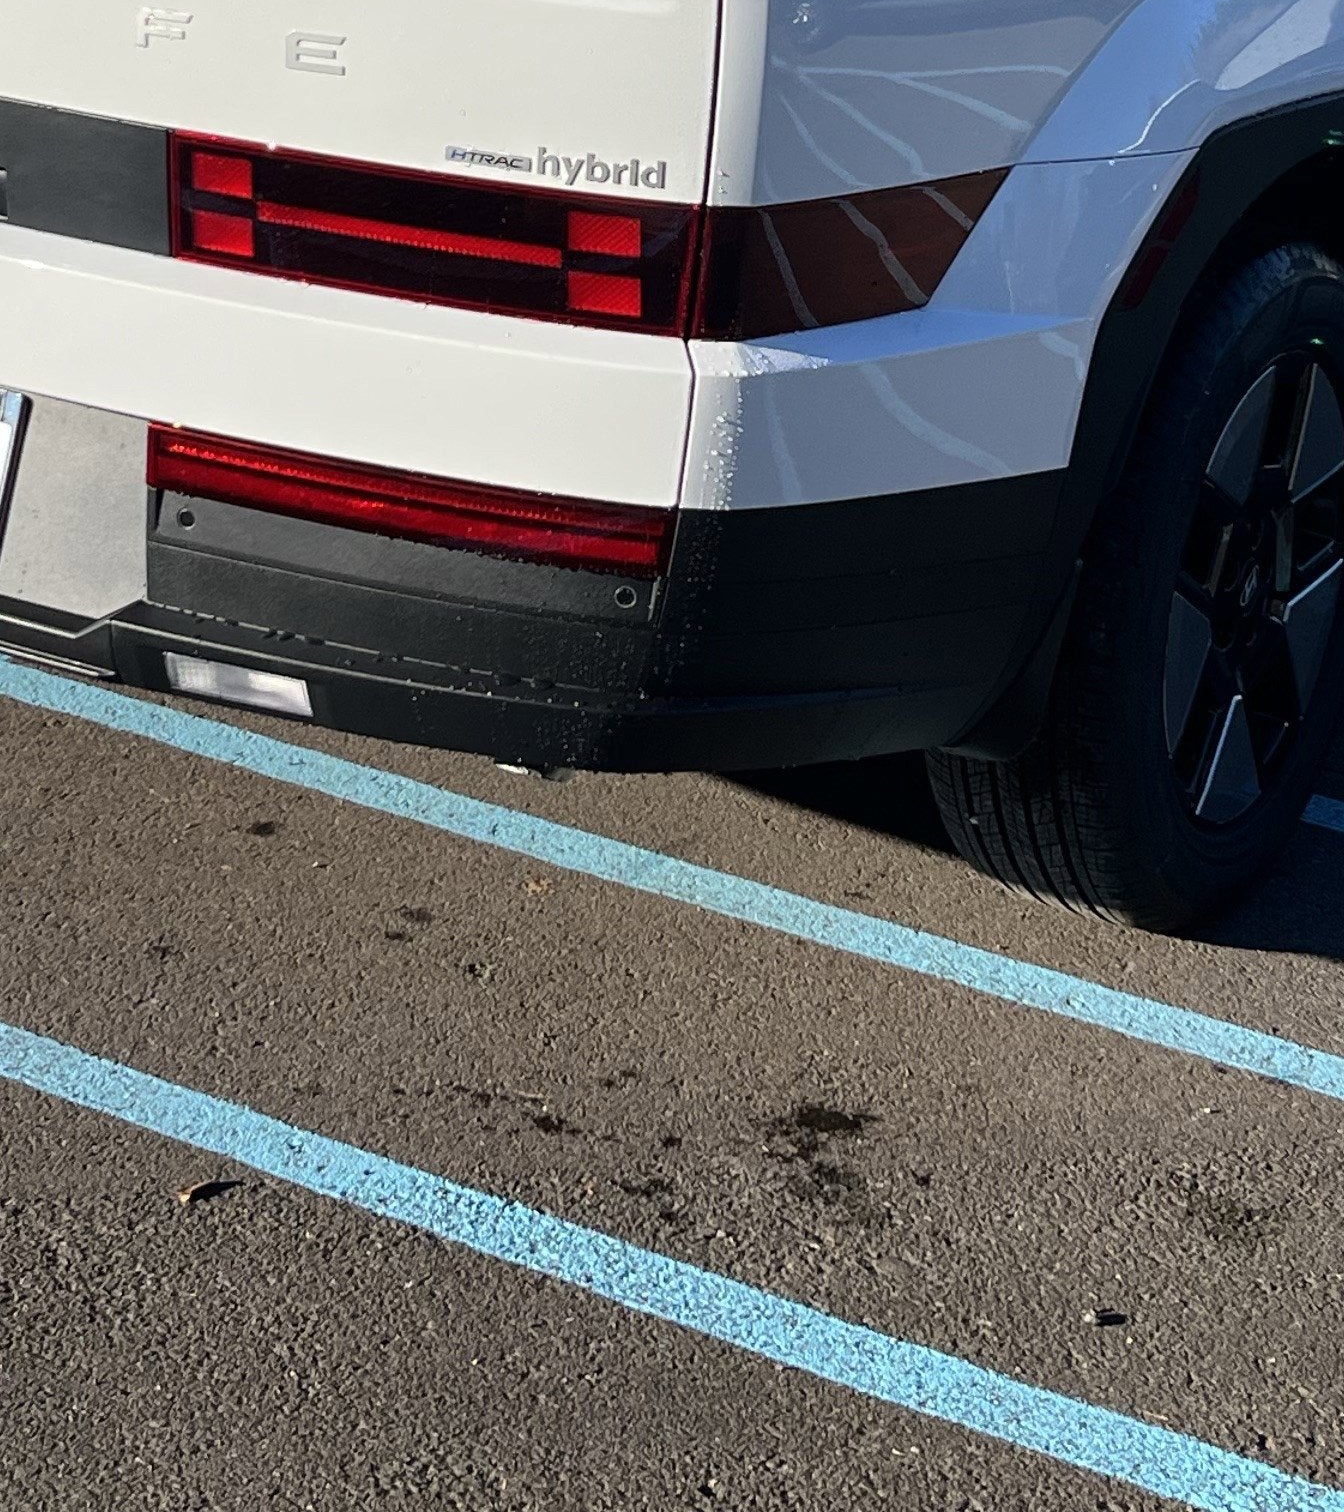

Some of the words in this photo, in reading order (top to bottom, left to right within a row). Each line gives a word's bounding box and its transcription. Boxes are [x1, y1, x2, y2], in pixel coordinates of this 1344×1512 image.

[134, 6, 348, 77] FE
[449, 148, 525, 170] HTRAC
[536, 146, 667, 190] hybrid
